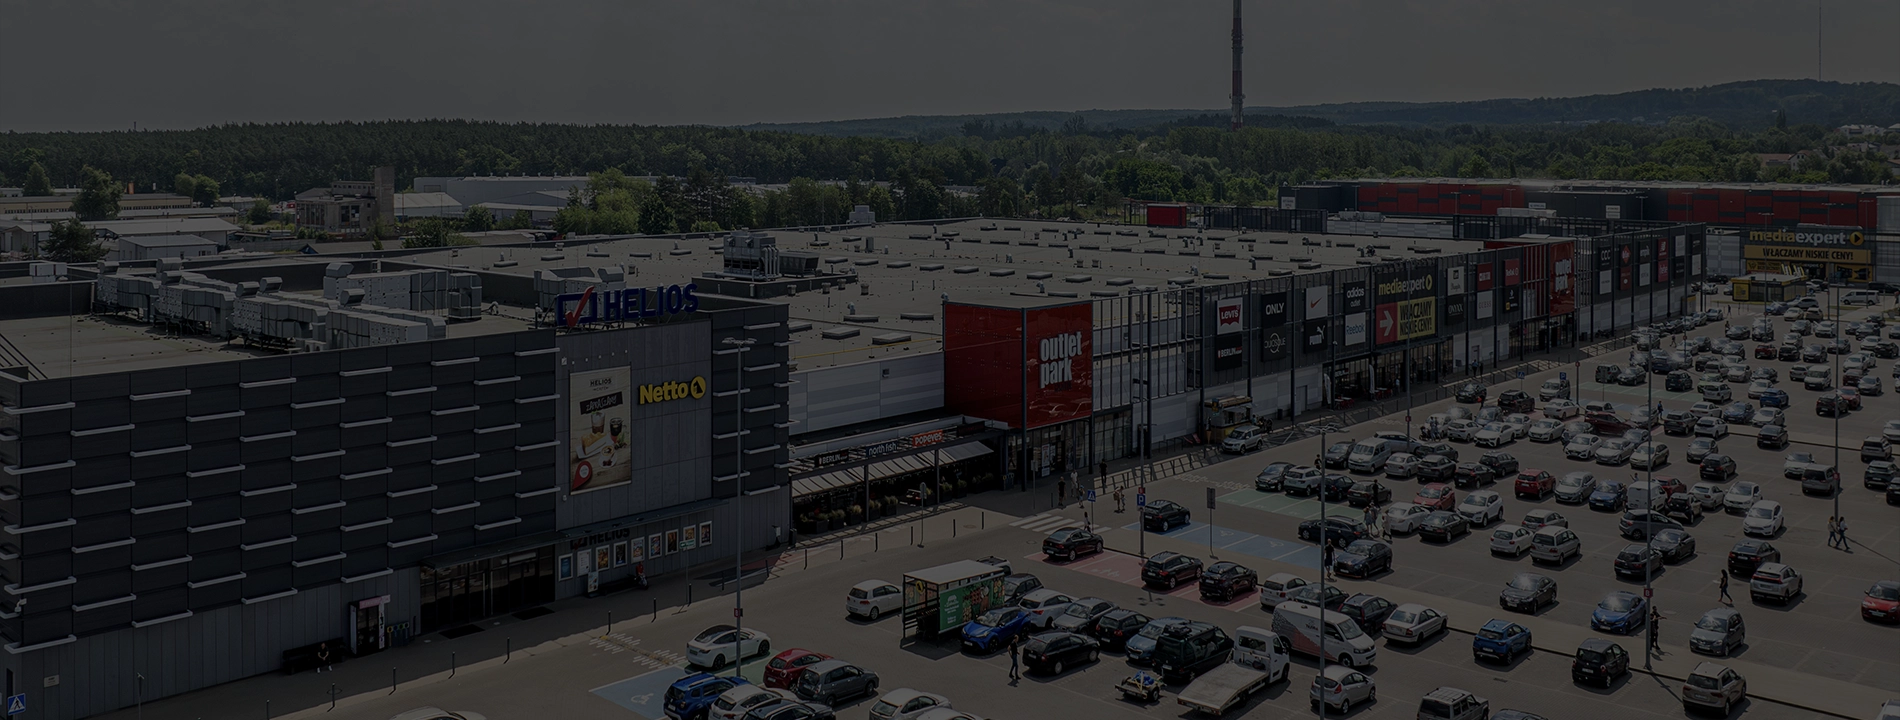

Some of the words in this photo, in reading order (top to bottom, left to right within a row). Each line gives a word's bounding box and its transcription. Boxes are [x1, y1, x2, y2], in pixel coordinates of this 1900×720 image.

[1750, 229, 1846, 246] mediaexpert
[1805, 250, 1829, 259] NISKIE
[1831, 251, 1853, 260] CENY!
[1346, 287, 1364, 298] adidas
[604, 284, 699, 321] HELIOS
[1265, 302, 1285, 315] ONLY
[1346, 325, 1364, 335] Reebok
[1040, 331, 1082, 361] outlet
[1040, 357, 1072, 389] park
[590, 378, 612, 387] HELIOS
[640, 380, 688, 405] Netto
[868, 444, 885, 456] north
[886, 442, 897, 453] fish
[822, 454, 841, 464] BERLIN
[1139, 495, 1144, 504] P
